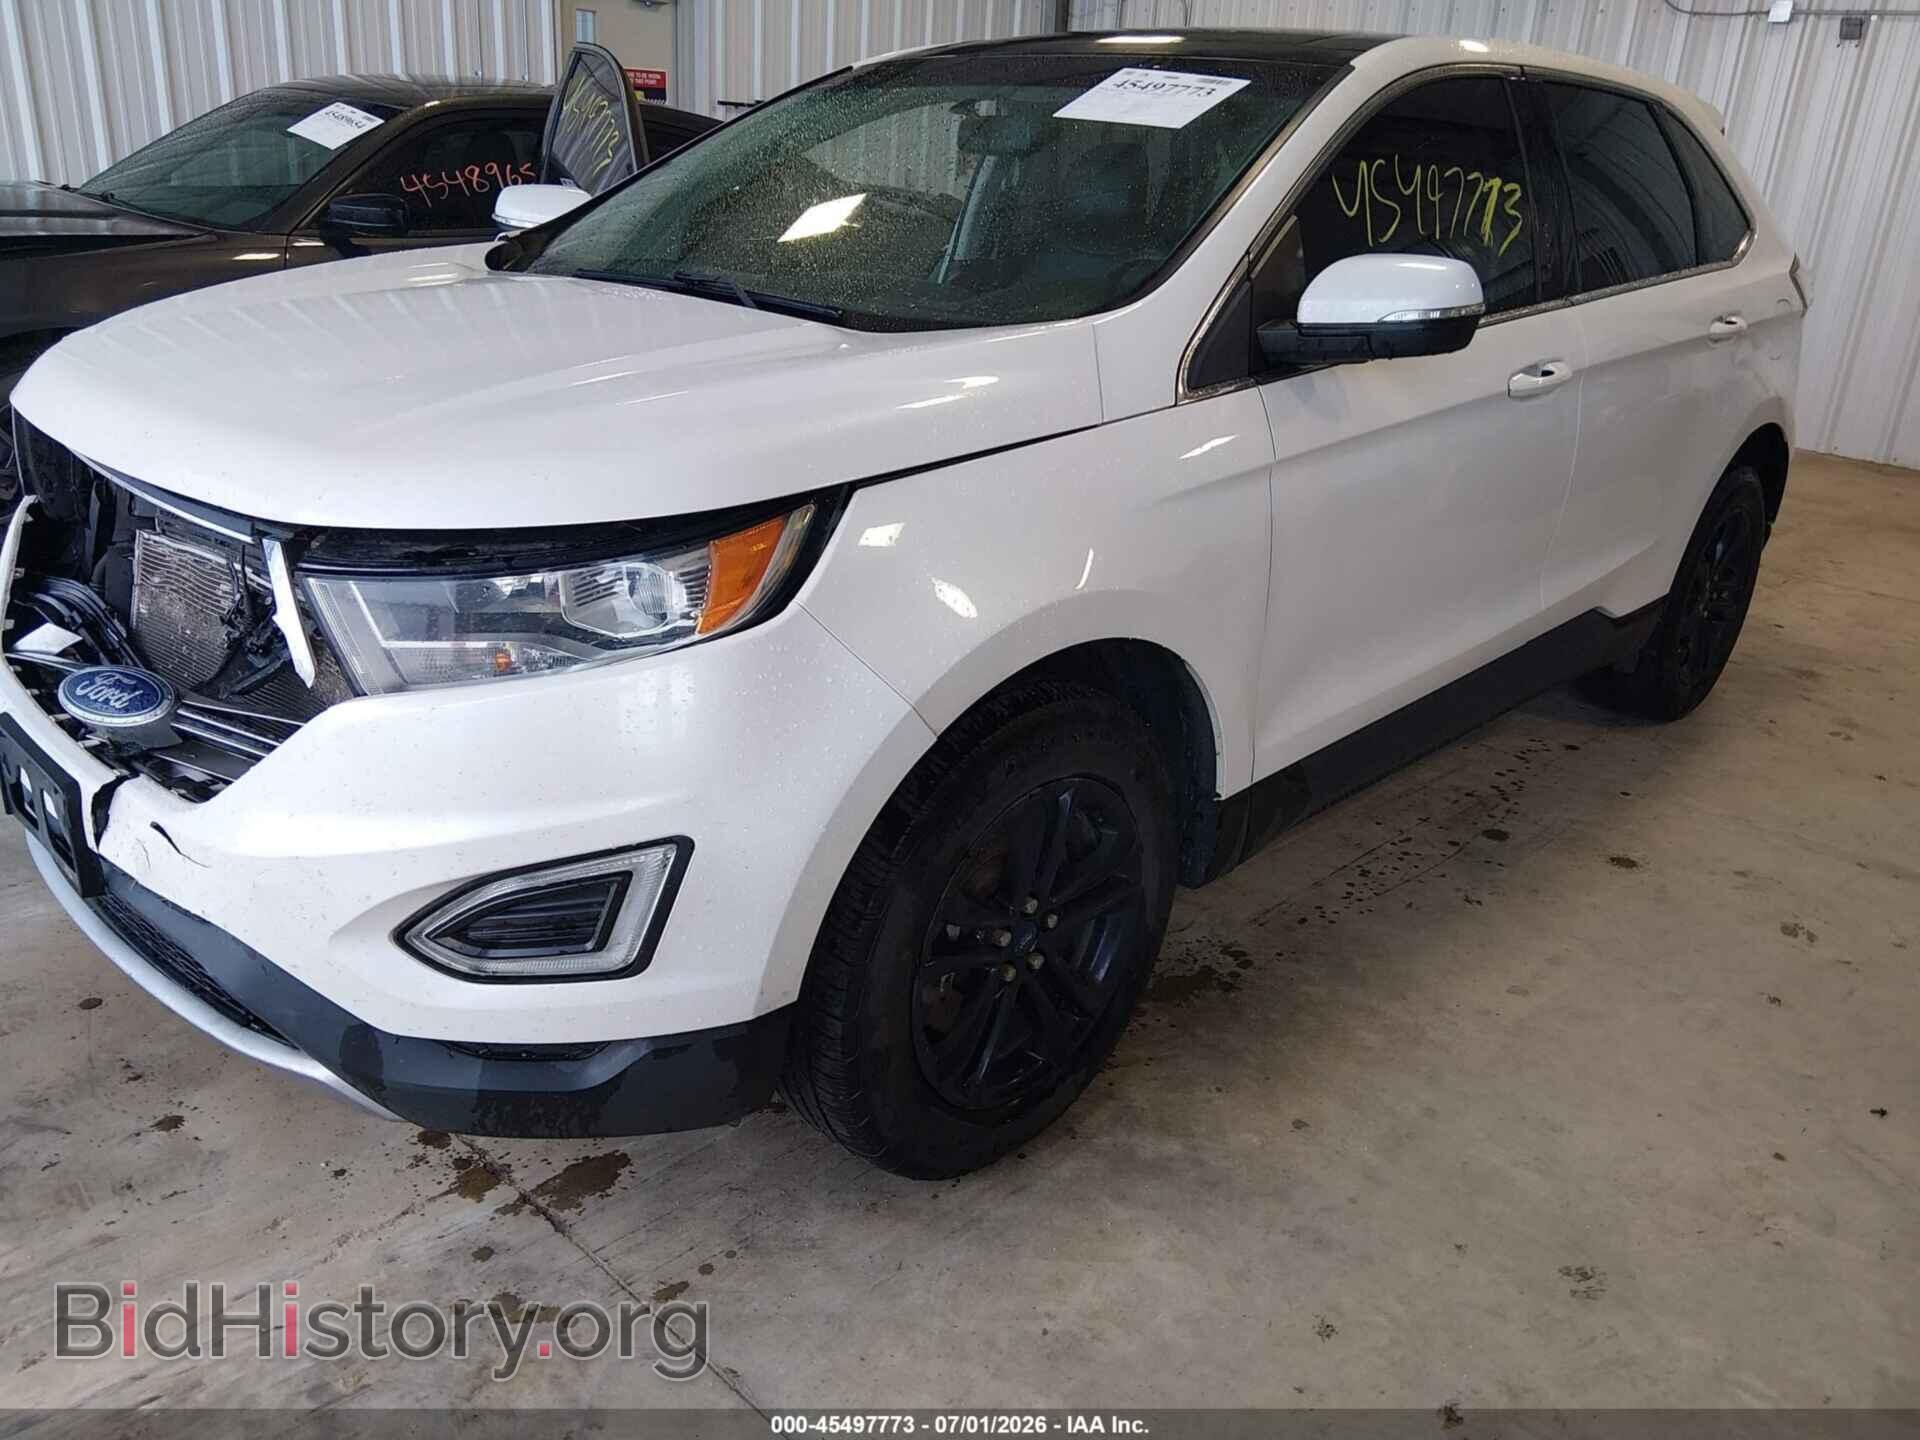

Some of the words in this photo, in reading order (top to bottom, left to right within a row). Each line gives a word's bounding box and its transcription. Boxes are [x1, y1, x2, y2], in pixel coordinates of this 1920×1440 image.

[1112, 79, 1217, 98] 45497773
[1332, 153, 1523, 257] 45497773
[75, 672, 143, 709] Ford
